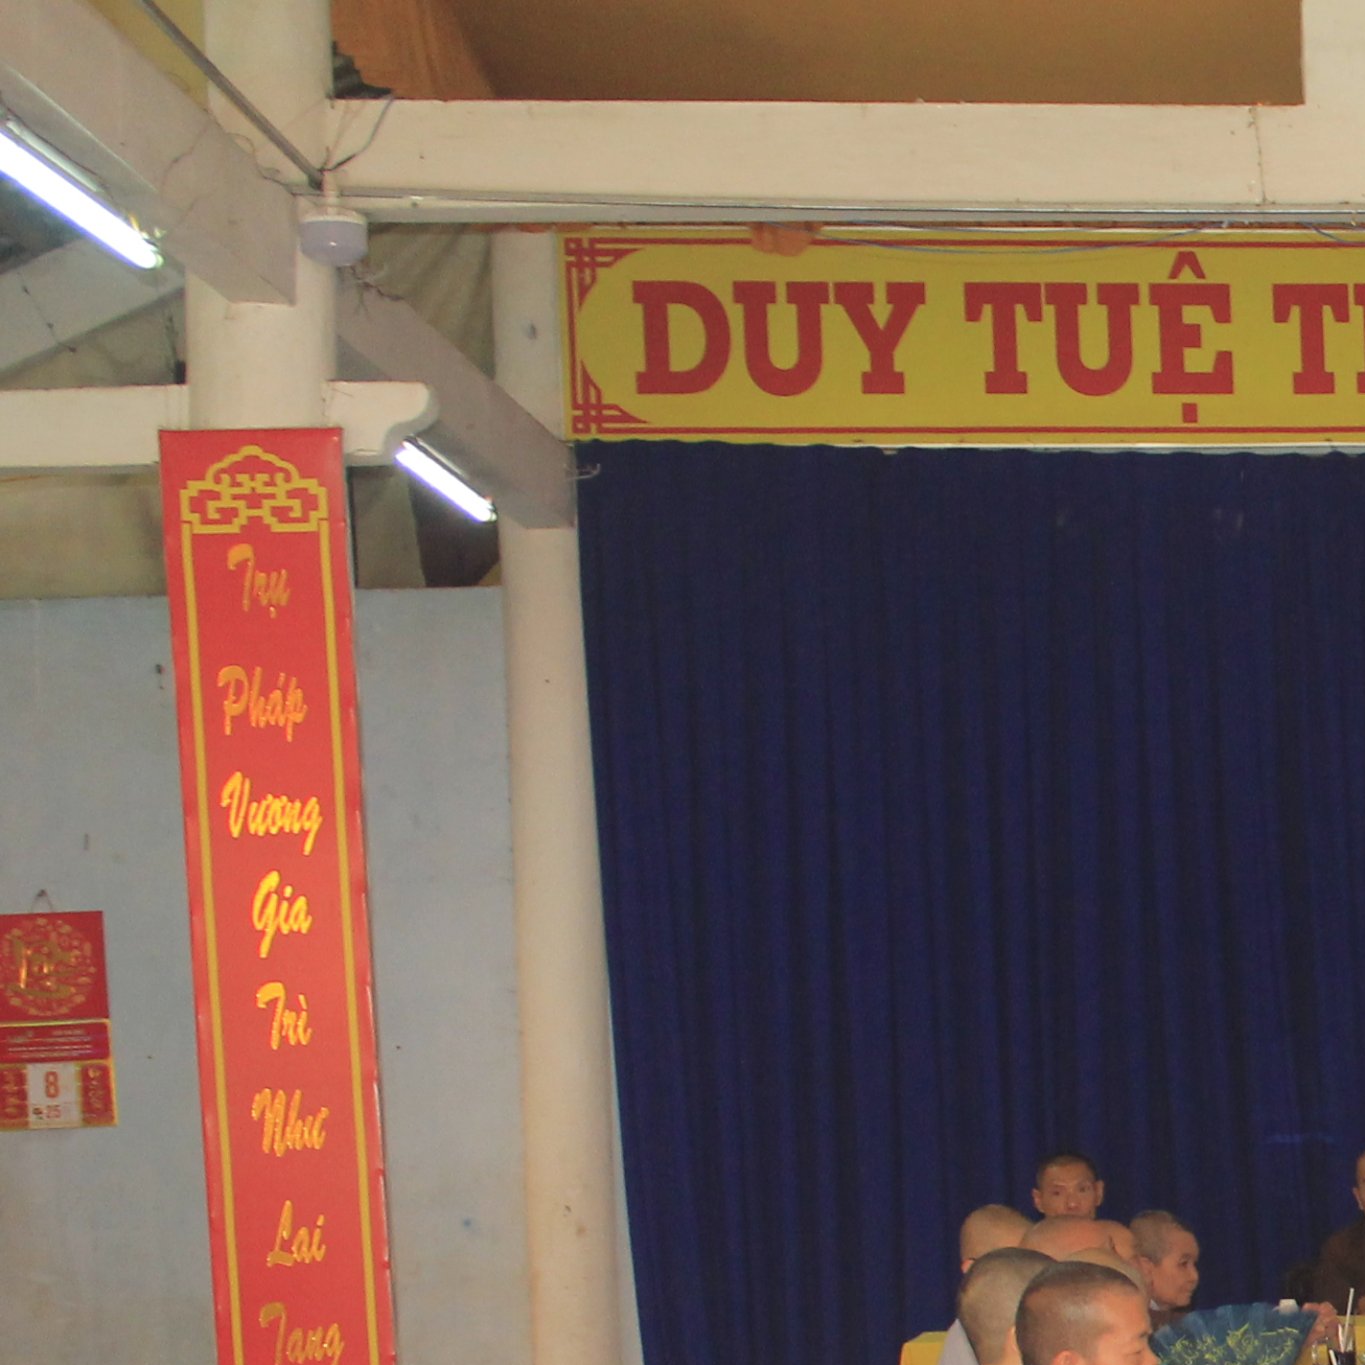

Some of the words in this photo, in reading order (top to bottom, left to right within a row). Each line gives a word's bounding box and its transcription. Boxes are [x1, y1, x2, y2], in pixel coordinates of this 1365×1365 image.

[631, 280, 925, 397] DUY
[964, 250, 1234, 424] TUỆ
[227, 543, 289, 618] Trụ
[217, 665, 308, 742] Pháp
[219, 770, 323, 856] Vương
[251, 870, 313, 959] Gia
[255, 981, 314, 1050] Trì
[251, 1087, 330, 1158] Như
[265, 1199, 326, 1268] Lai
